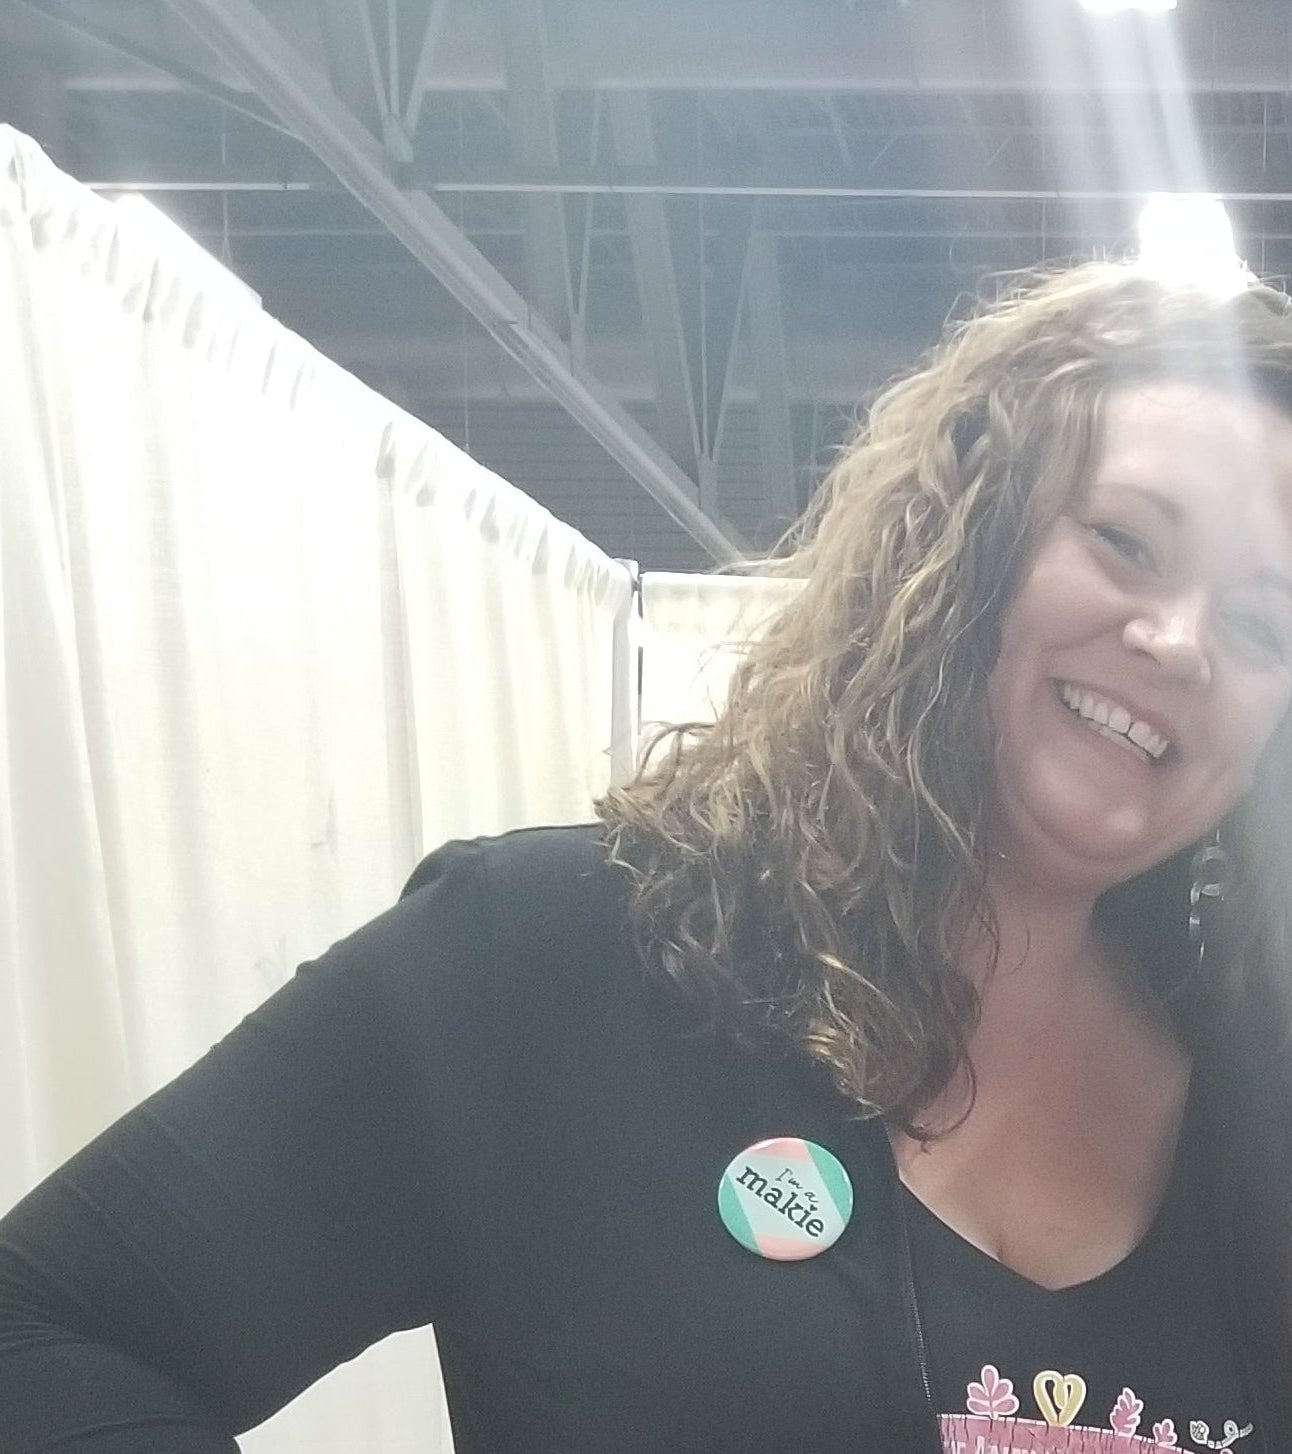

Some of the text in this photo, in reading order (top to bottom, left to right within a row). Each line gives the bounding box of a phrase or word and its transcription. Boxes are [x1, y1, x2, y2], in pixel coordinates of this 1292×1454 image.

[736, 1166, 824, 1237] makie
[775, 1168, 819, 1204] I'm a
